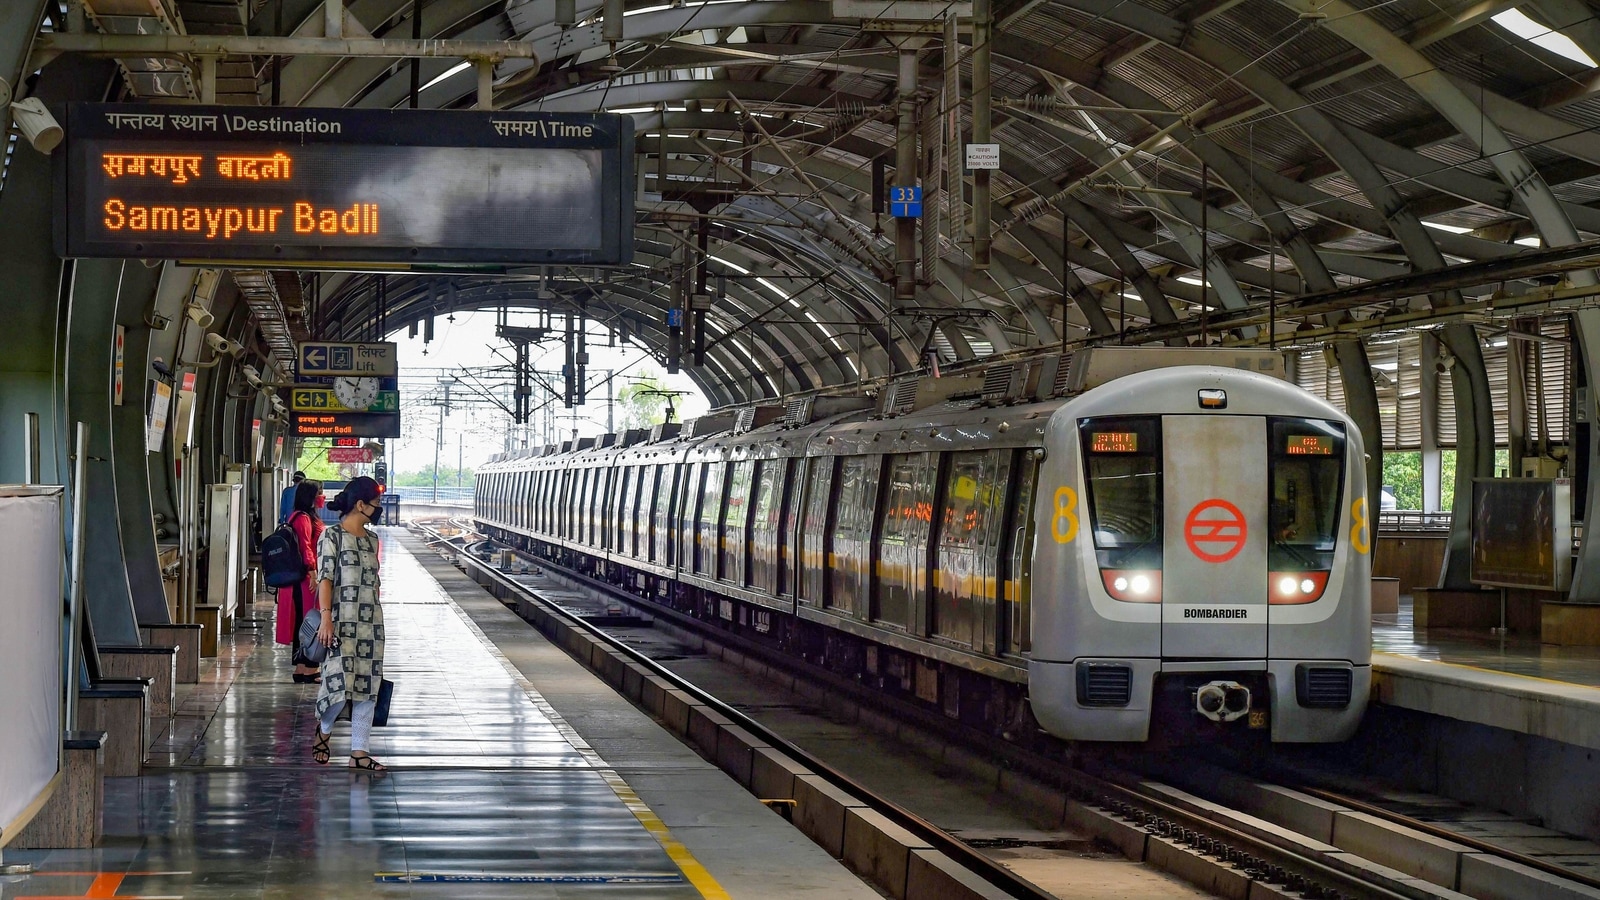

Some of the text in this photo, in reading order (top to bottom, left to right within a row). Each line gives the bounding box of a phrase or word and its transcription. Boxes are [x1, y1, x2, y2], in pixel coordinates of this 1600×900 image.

[105, 112, 165, 130] गन्तव्य
[169, 114, 218, 131] स्थान
[103, 153, 291, 183] समयपुर बादली
[898, 188, 914, 201] 33
[104, 200, 378, 238] Samaypur Badli
[356, 361, 376, 371] Lift
[298, 426, 333, 435] Samaypur
[1051, 486, 1079, 544] 8
[1350, 497, 1370, 555] 8
[1184, 608, 1247, 619] BOMBARDIER
